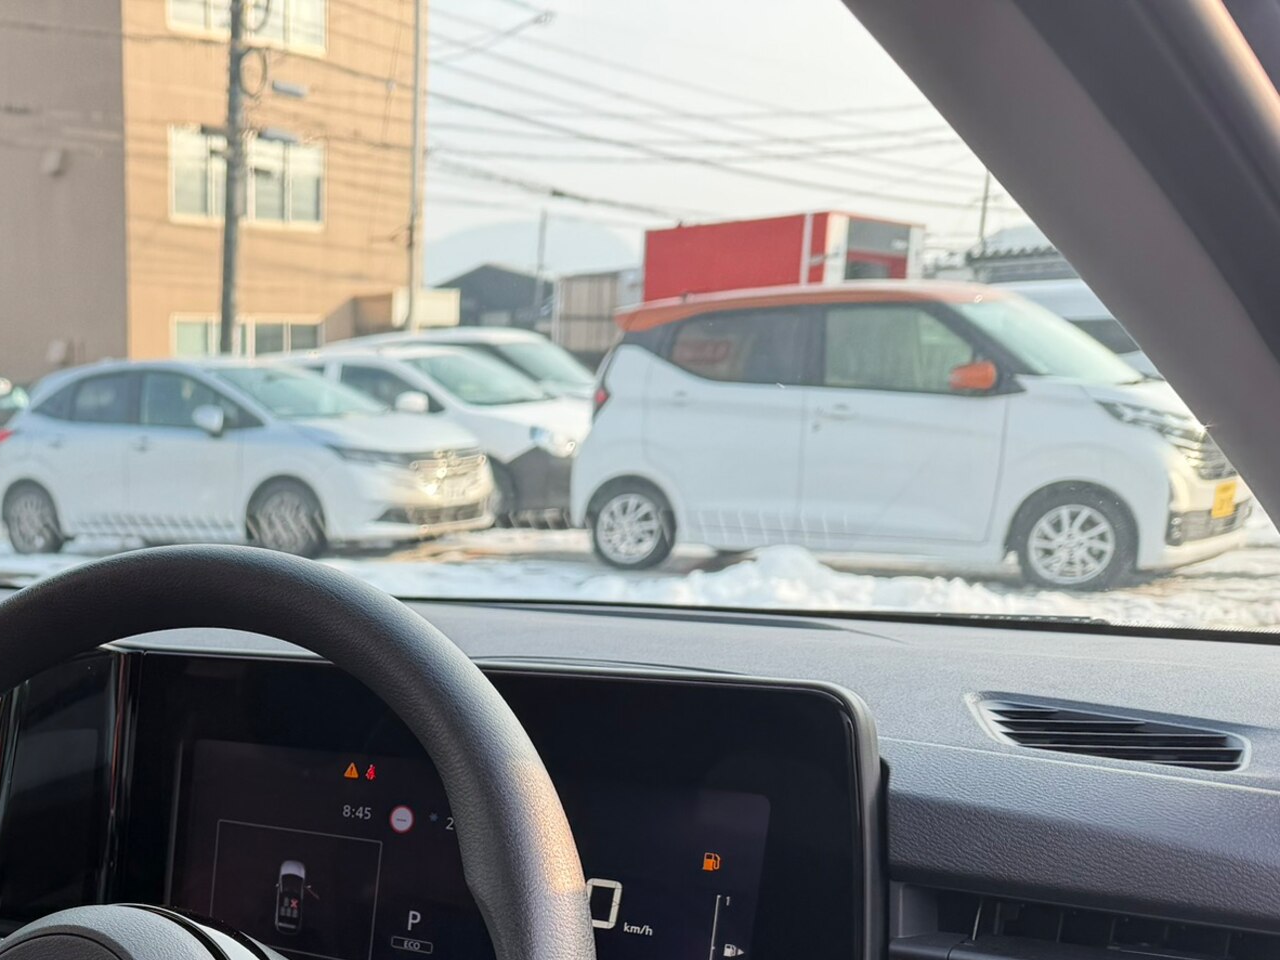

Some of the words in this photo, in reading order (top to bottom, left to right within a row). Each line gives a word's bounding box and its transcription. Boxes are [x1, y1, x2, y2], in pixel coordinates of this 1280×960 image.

[342, 804, 372, 820] 8:45
[586, 877, 622, 930] 0
[623, 922, 653, 937] km/h
[407, 910, 421, 931] P
[404, 940, 421, 951] ECO
